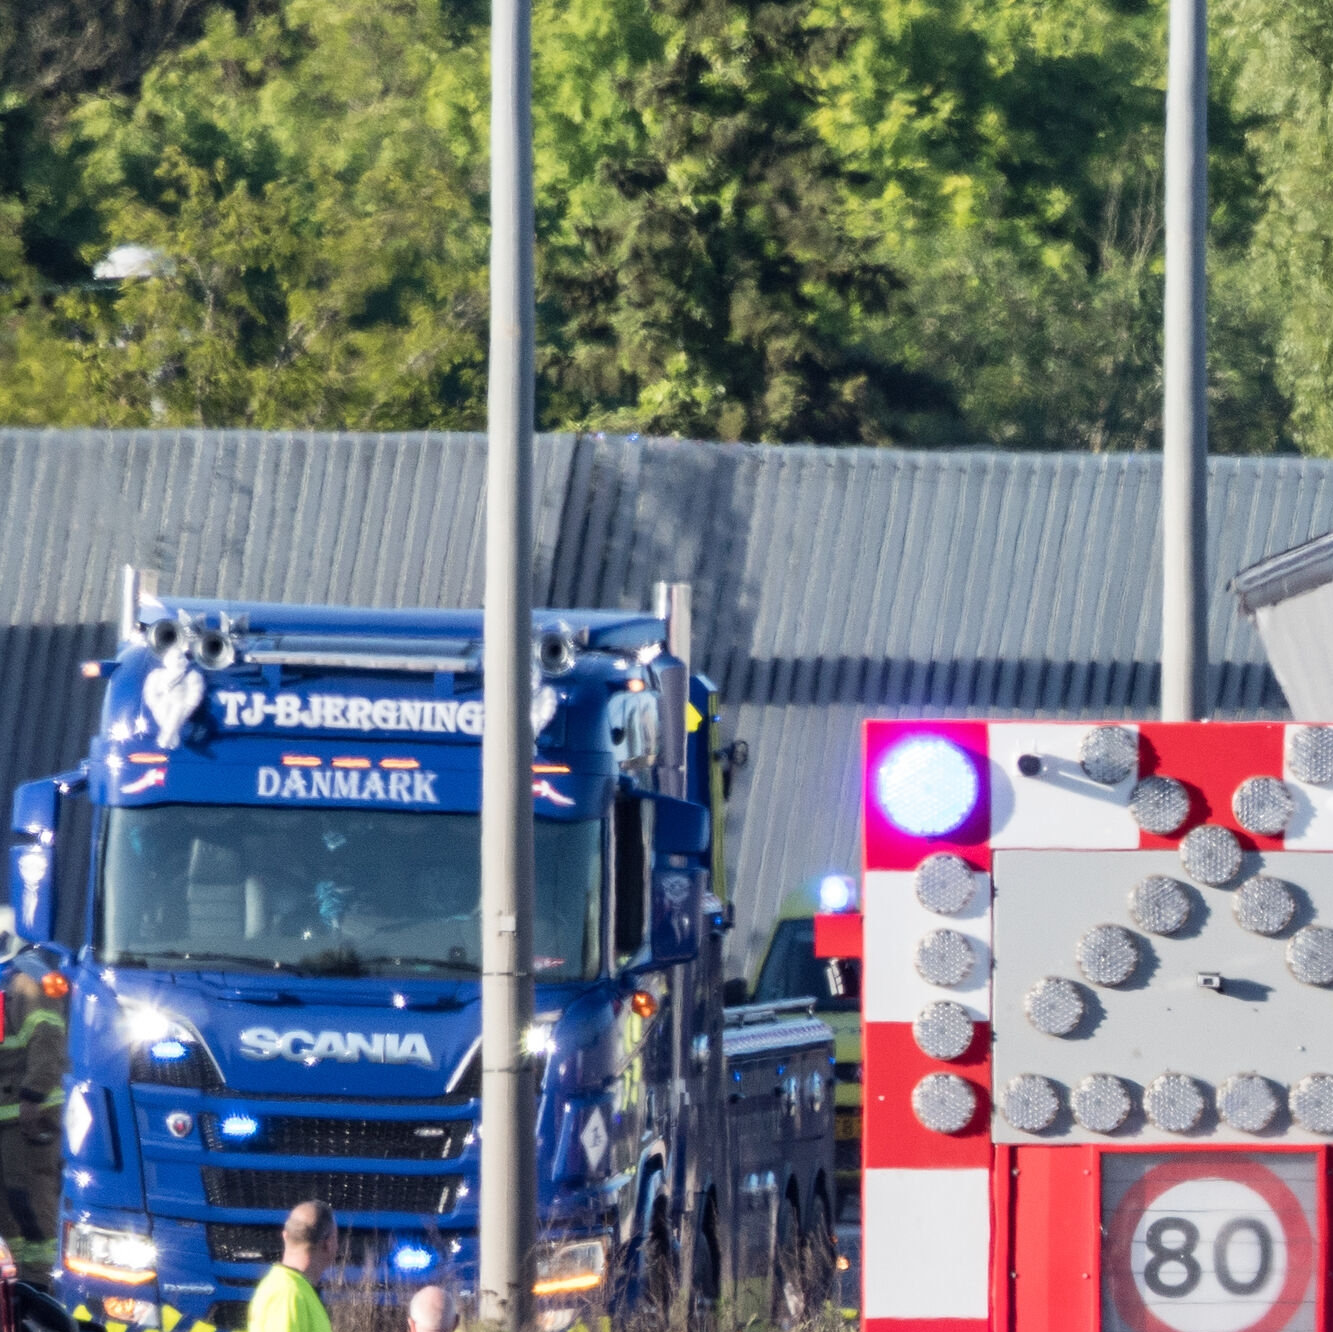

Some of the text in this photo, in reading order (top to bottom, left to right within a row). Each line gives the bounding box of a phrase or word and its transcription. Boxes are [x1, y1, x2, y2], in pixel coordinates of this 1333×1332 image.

[218, 691, 484, 735] TJ-BJERGNING
[257, 766, 439, 803] DANMARK
[240, 1027, 433, 1065] SCANIA
[1144, 1216, 1273, 1298] 80
